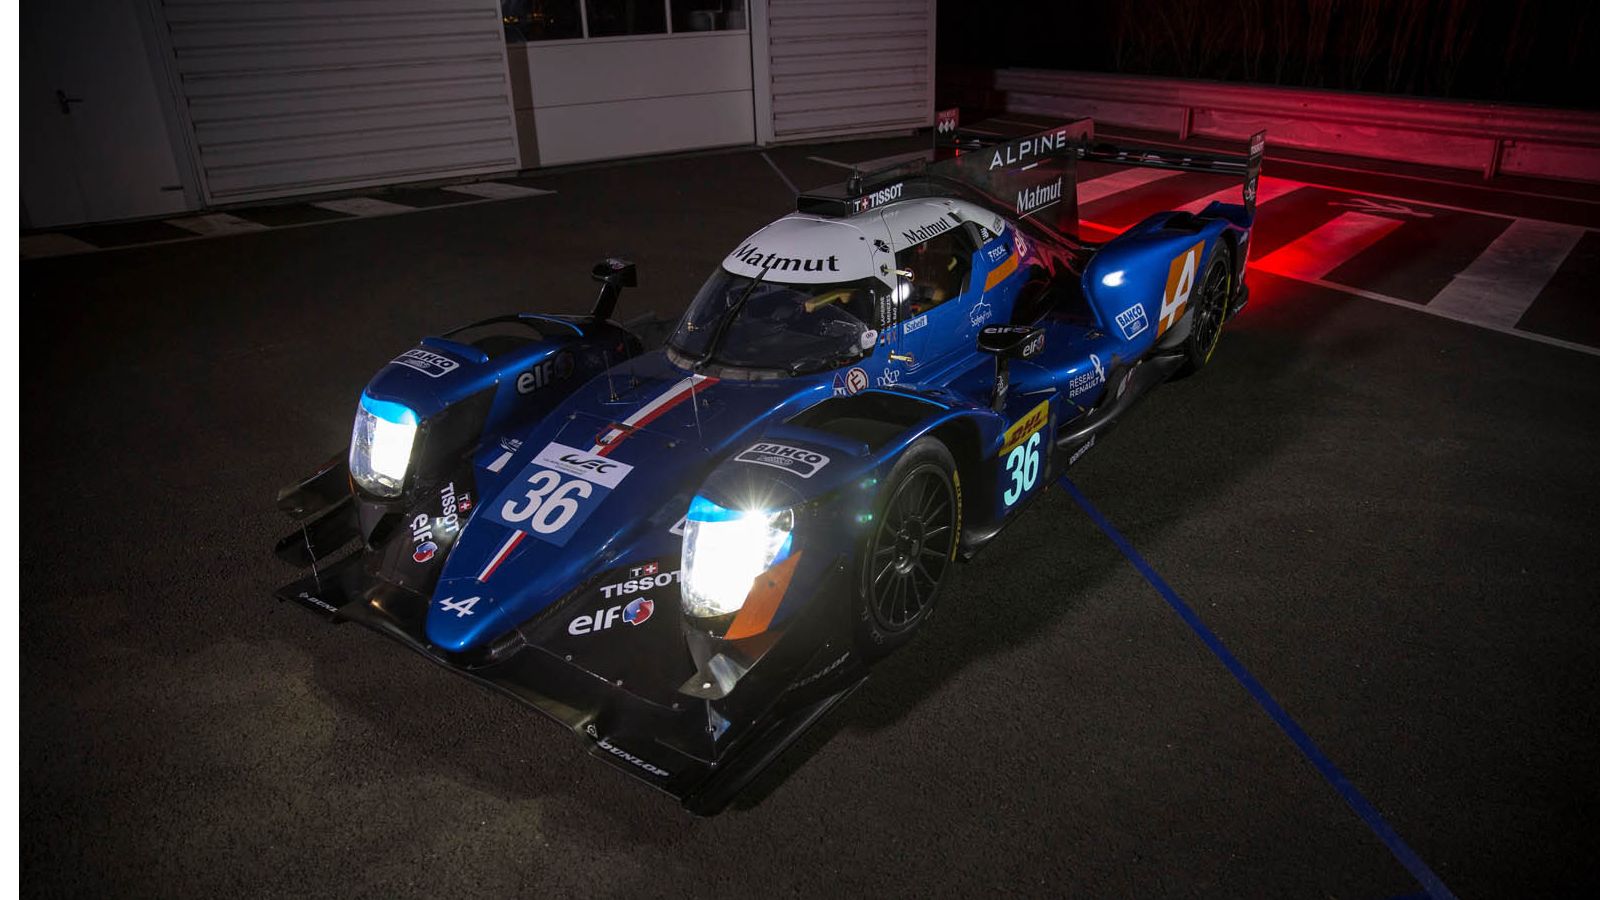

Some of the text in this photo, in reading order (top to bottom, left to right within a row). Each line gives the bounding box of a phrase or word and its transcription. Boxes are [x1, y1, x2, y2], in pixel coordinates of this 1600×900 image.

[989, 130, 1067, 170] ALPINE
[869, 183, 903, 207] TISSOT
[1016, 177, 1062, 213] Matmut
[902, 217, 950, 245] Matmut
[731, 243, 840, 272] Matmut
[1117, 305, 1142, 327] BAHCO
[405, 350, 454, 367] BAHCO
[1023, 338, 1038, 356] elf
[516, 361, 554, 394] elf
[1069, 370, 1095, 389] RÉSEAU
[1069, 376, 1100, 398] RENAULT
[1008, 410, 1042, 445] DHL
[752, 444, 823, 464] BAHCO
[1004, 432, 1040, 507] 36
[440, 482, 460, 533] TISSOT
[501, 470, 593, 534] 36
[409, 512, 434, 545] elf
[567, 605, 622, 636] elf
[596, 738, 670, 777] DUNLOP
